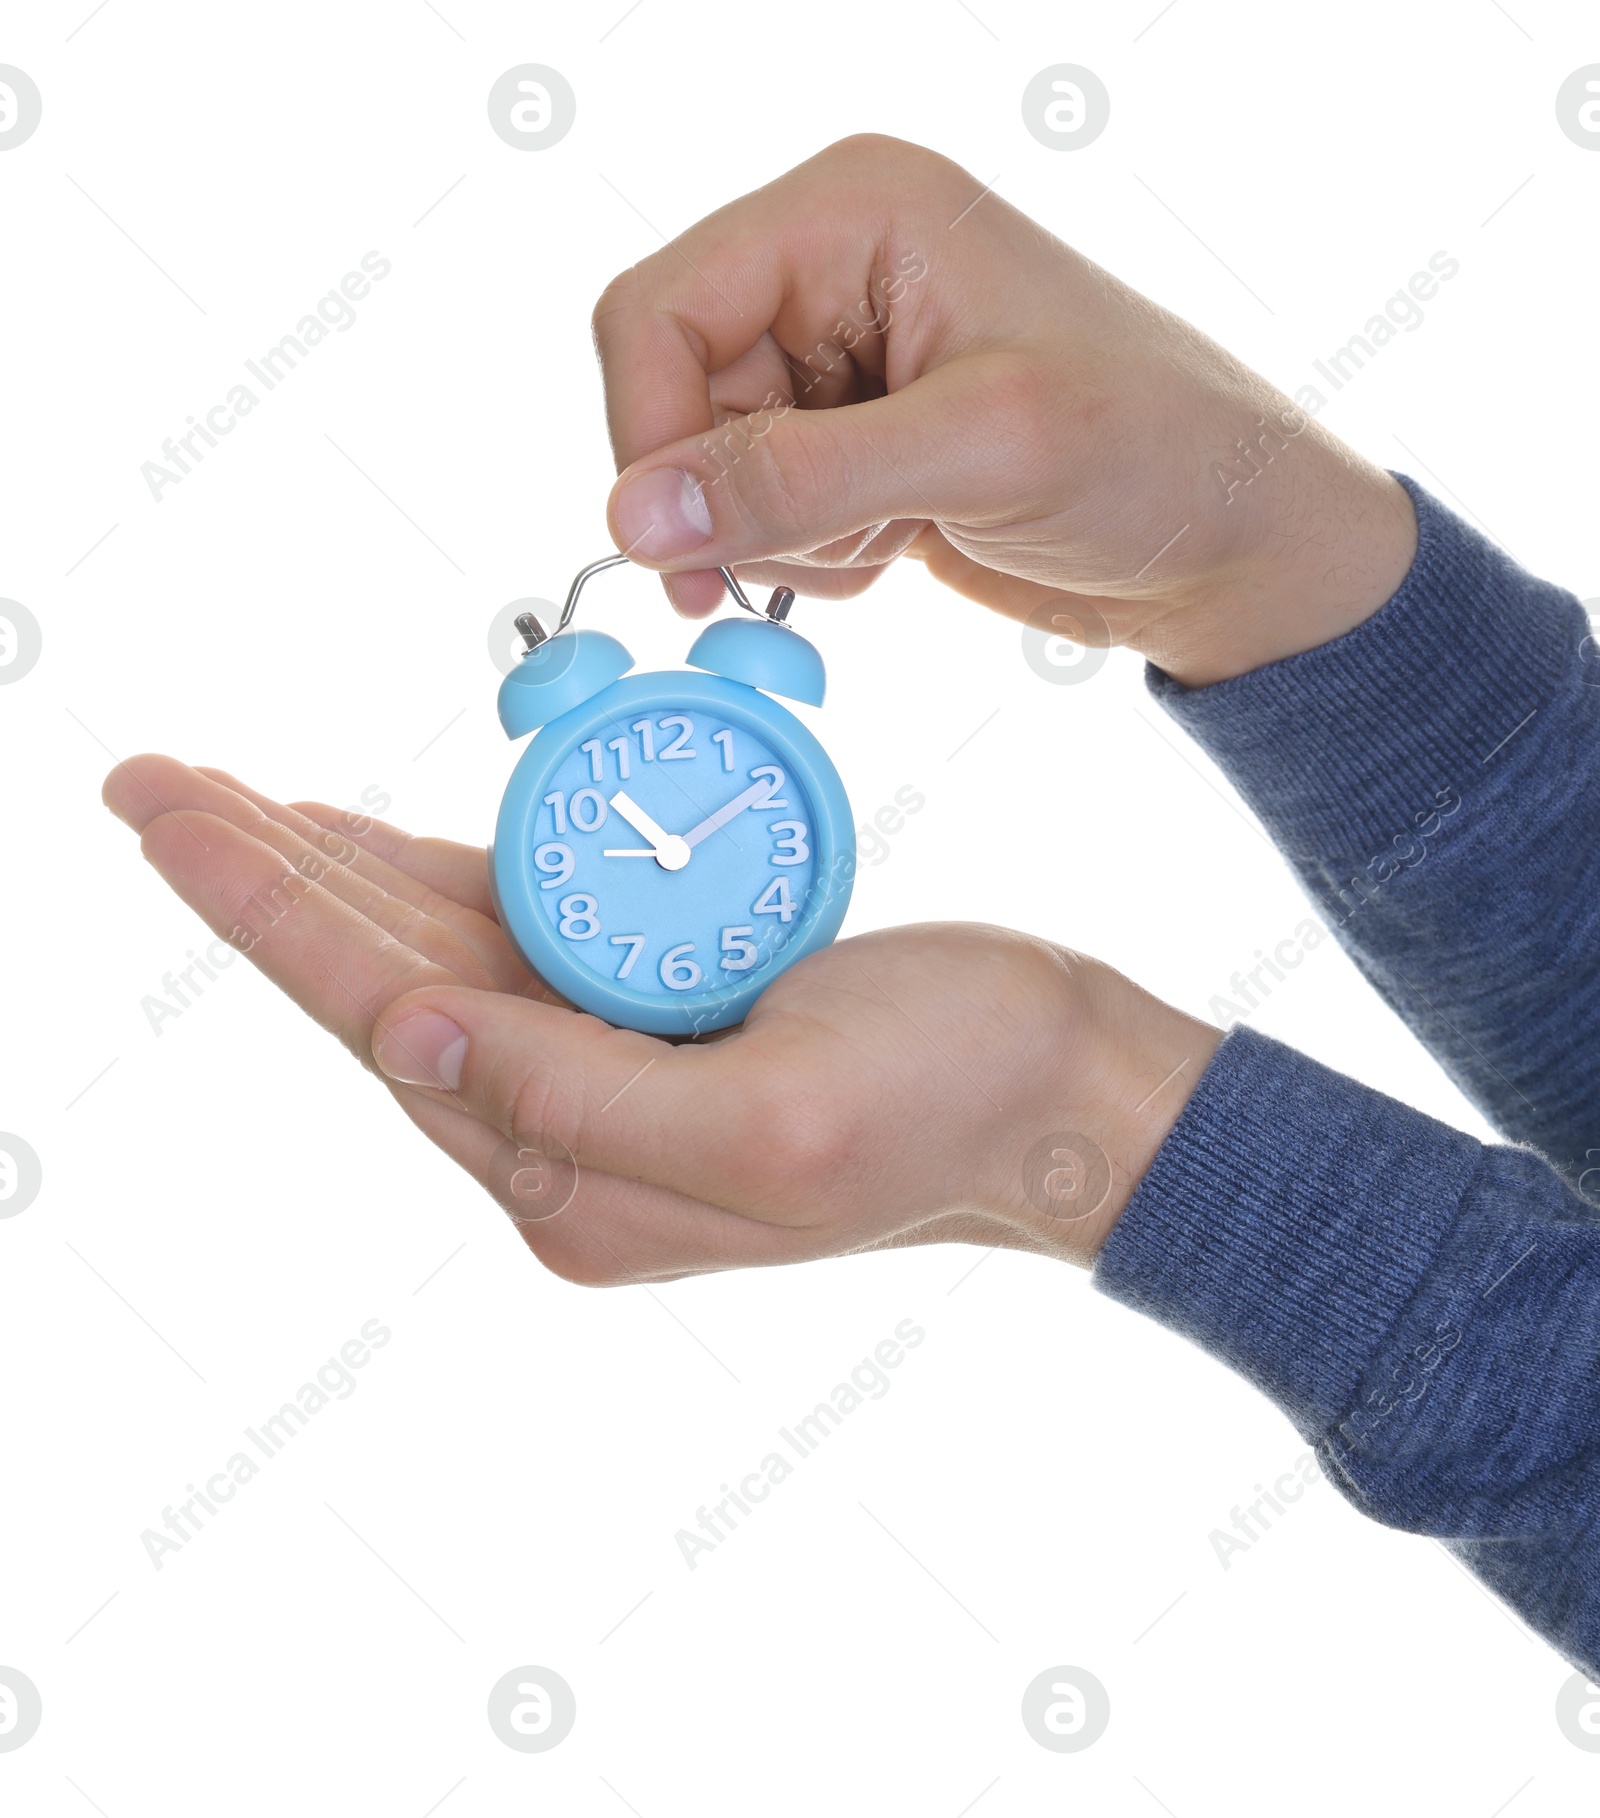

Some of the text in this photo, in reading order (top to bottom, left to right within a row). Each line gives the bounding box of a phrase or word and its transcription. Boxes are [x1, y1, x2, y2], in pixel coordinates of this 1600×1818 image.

[581, 737, 631, 781] 11
[633, 715, 697, 761] 12
[712, 729, 735, 771] 1
[544, 787, 608, 834] 10
[750, 765, 789, 810] 2
[534, 841, 576, 889] 9
[769, 819, 810, 867] 3
[558, 893, 601, 941] 8
[752, 876, 798, 923] 4
[610, 933, 647, 980] 7
[659, 943, 701, 991] 6
[721, 925, 759, 971] 5
